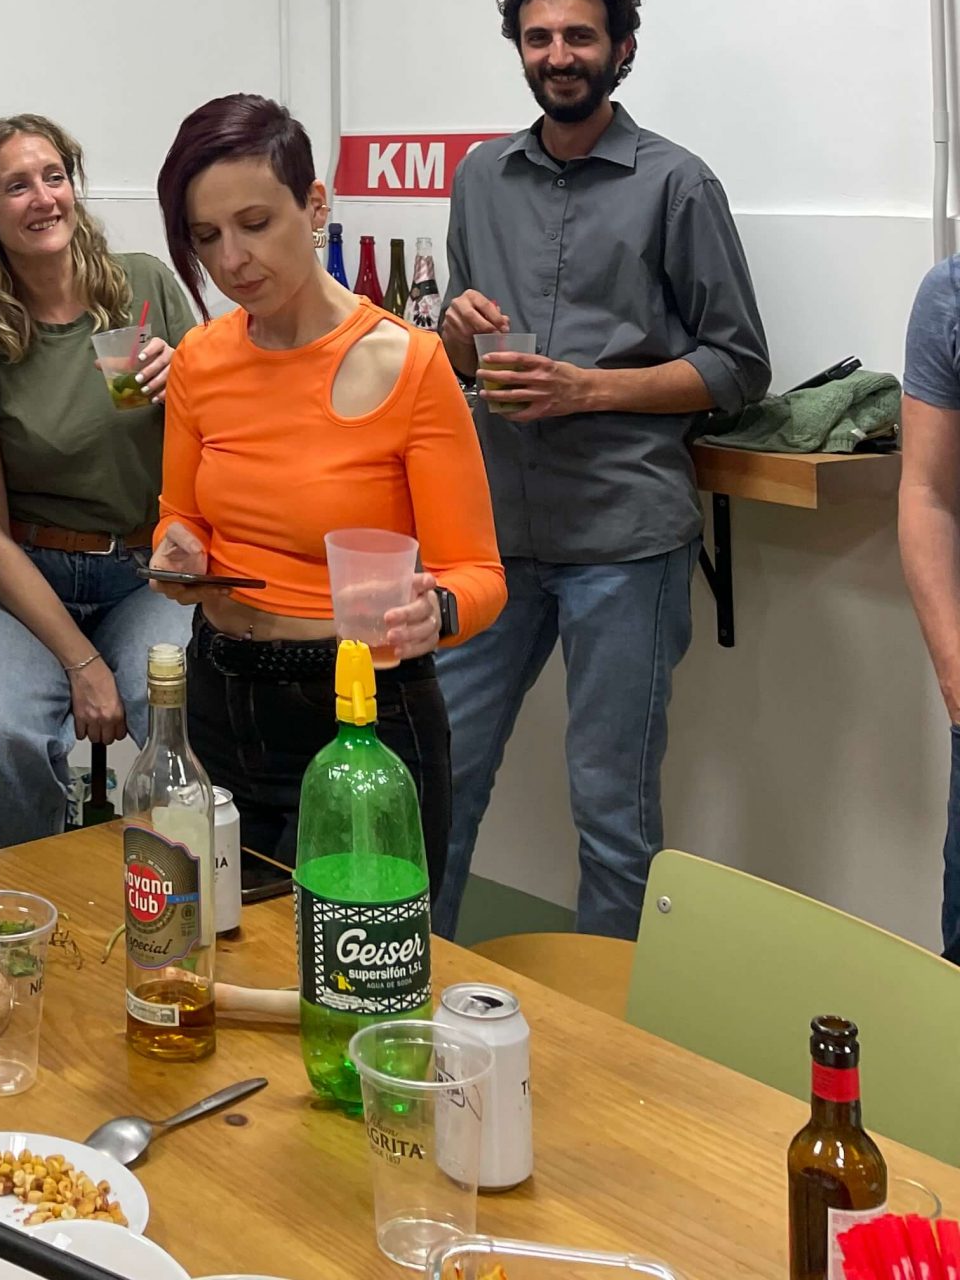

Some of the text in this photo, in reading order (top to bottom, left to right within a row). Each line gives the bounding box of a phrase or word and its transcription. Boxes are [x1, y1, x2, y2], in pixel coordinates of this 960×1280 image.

[367, 142, 445, 189] KM
[129, 888, 159, 914] Club
[336, 928, 425, 966] Geiser
[348, 966, 406, 982] supersifón
